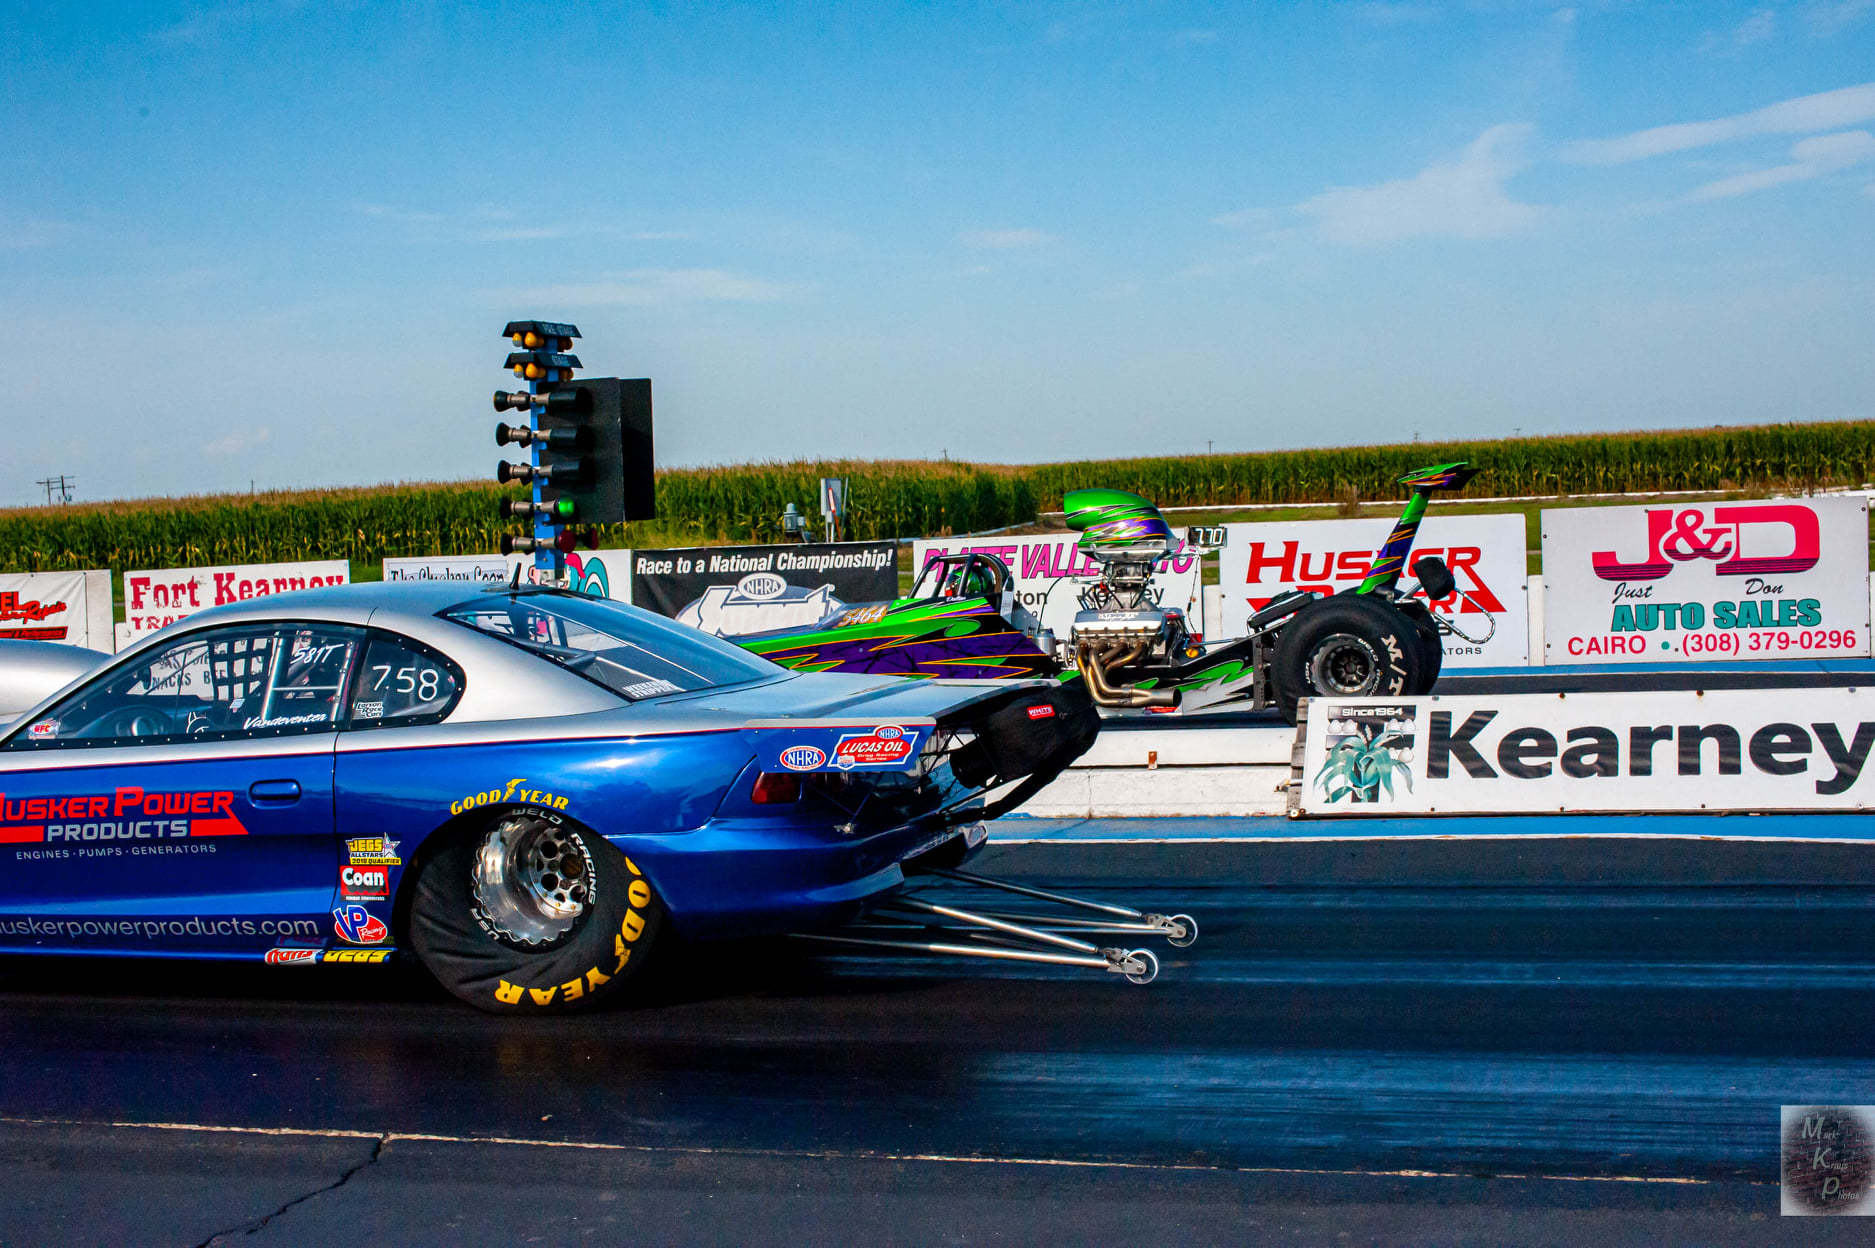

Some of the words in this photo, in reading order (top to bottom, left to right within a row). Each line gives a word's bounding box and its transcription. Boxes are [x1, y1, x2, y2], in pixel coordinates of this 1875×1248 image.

[1592, 505, 1820, 581] J&D
[637, 557, 672, 574] Race
[677, 556, 690, 573] to
[696, 559, 705, 572] a
[710, 553, 772, 573] National
[777, 549, 893, 572] Championship!
[1021, 541, 1100, 579] VALLE
[1246, 541, 1482, 584] HUSER
[130, 576, 200, 609] Fort
[745, 579, 780, 595] NHRA
[1081, 586, 1165, 605] Keey
[1612, 582, 1654, 603] Just
[1745, 578, 1783, 595] Don
[1611, 602, 1705, 632] AUTO
[1713, 599, 1822, 628] SALES
[1568, 635, 1647, 655] CAIRO
[1682, 633, 1740, 656] (308)
[1749, 630, 1856, 651] 379-0296
[788, 751, 819, 766] NHRA
[841, 742, 885, 754] LUCAS
[884, 742, 904, 752] OIL
[1427, 710, 1875, 795] Kearney
[114, 786, 235, 817] POWER
[47, 820, 188, 841] PRODUCTS
[16, 849, 70, 860] ENGINES
[79, 847, 122, 857] PUMPS
[132, 844, 217, 855] GENERATORS
[348, 839, 384, 852] JEGS
[512, 808, 563, 825] WELD
[571, 833, 597, 905] RACING
[342, 867, 384, 886] Coan
[333, 905, 370, 943] VP
